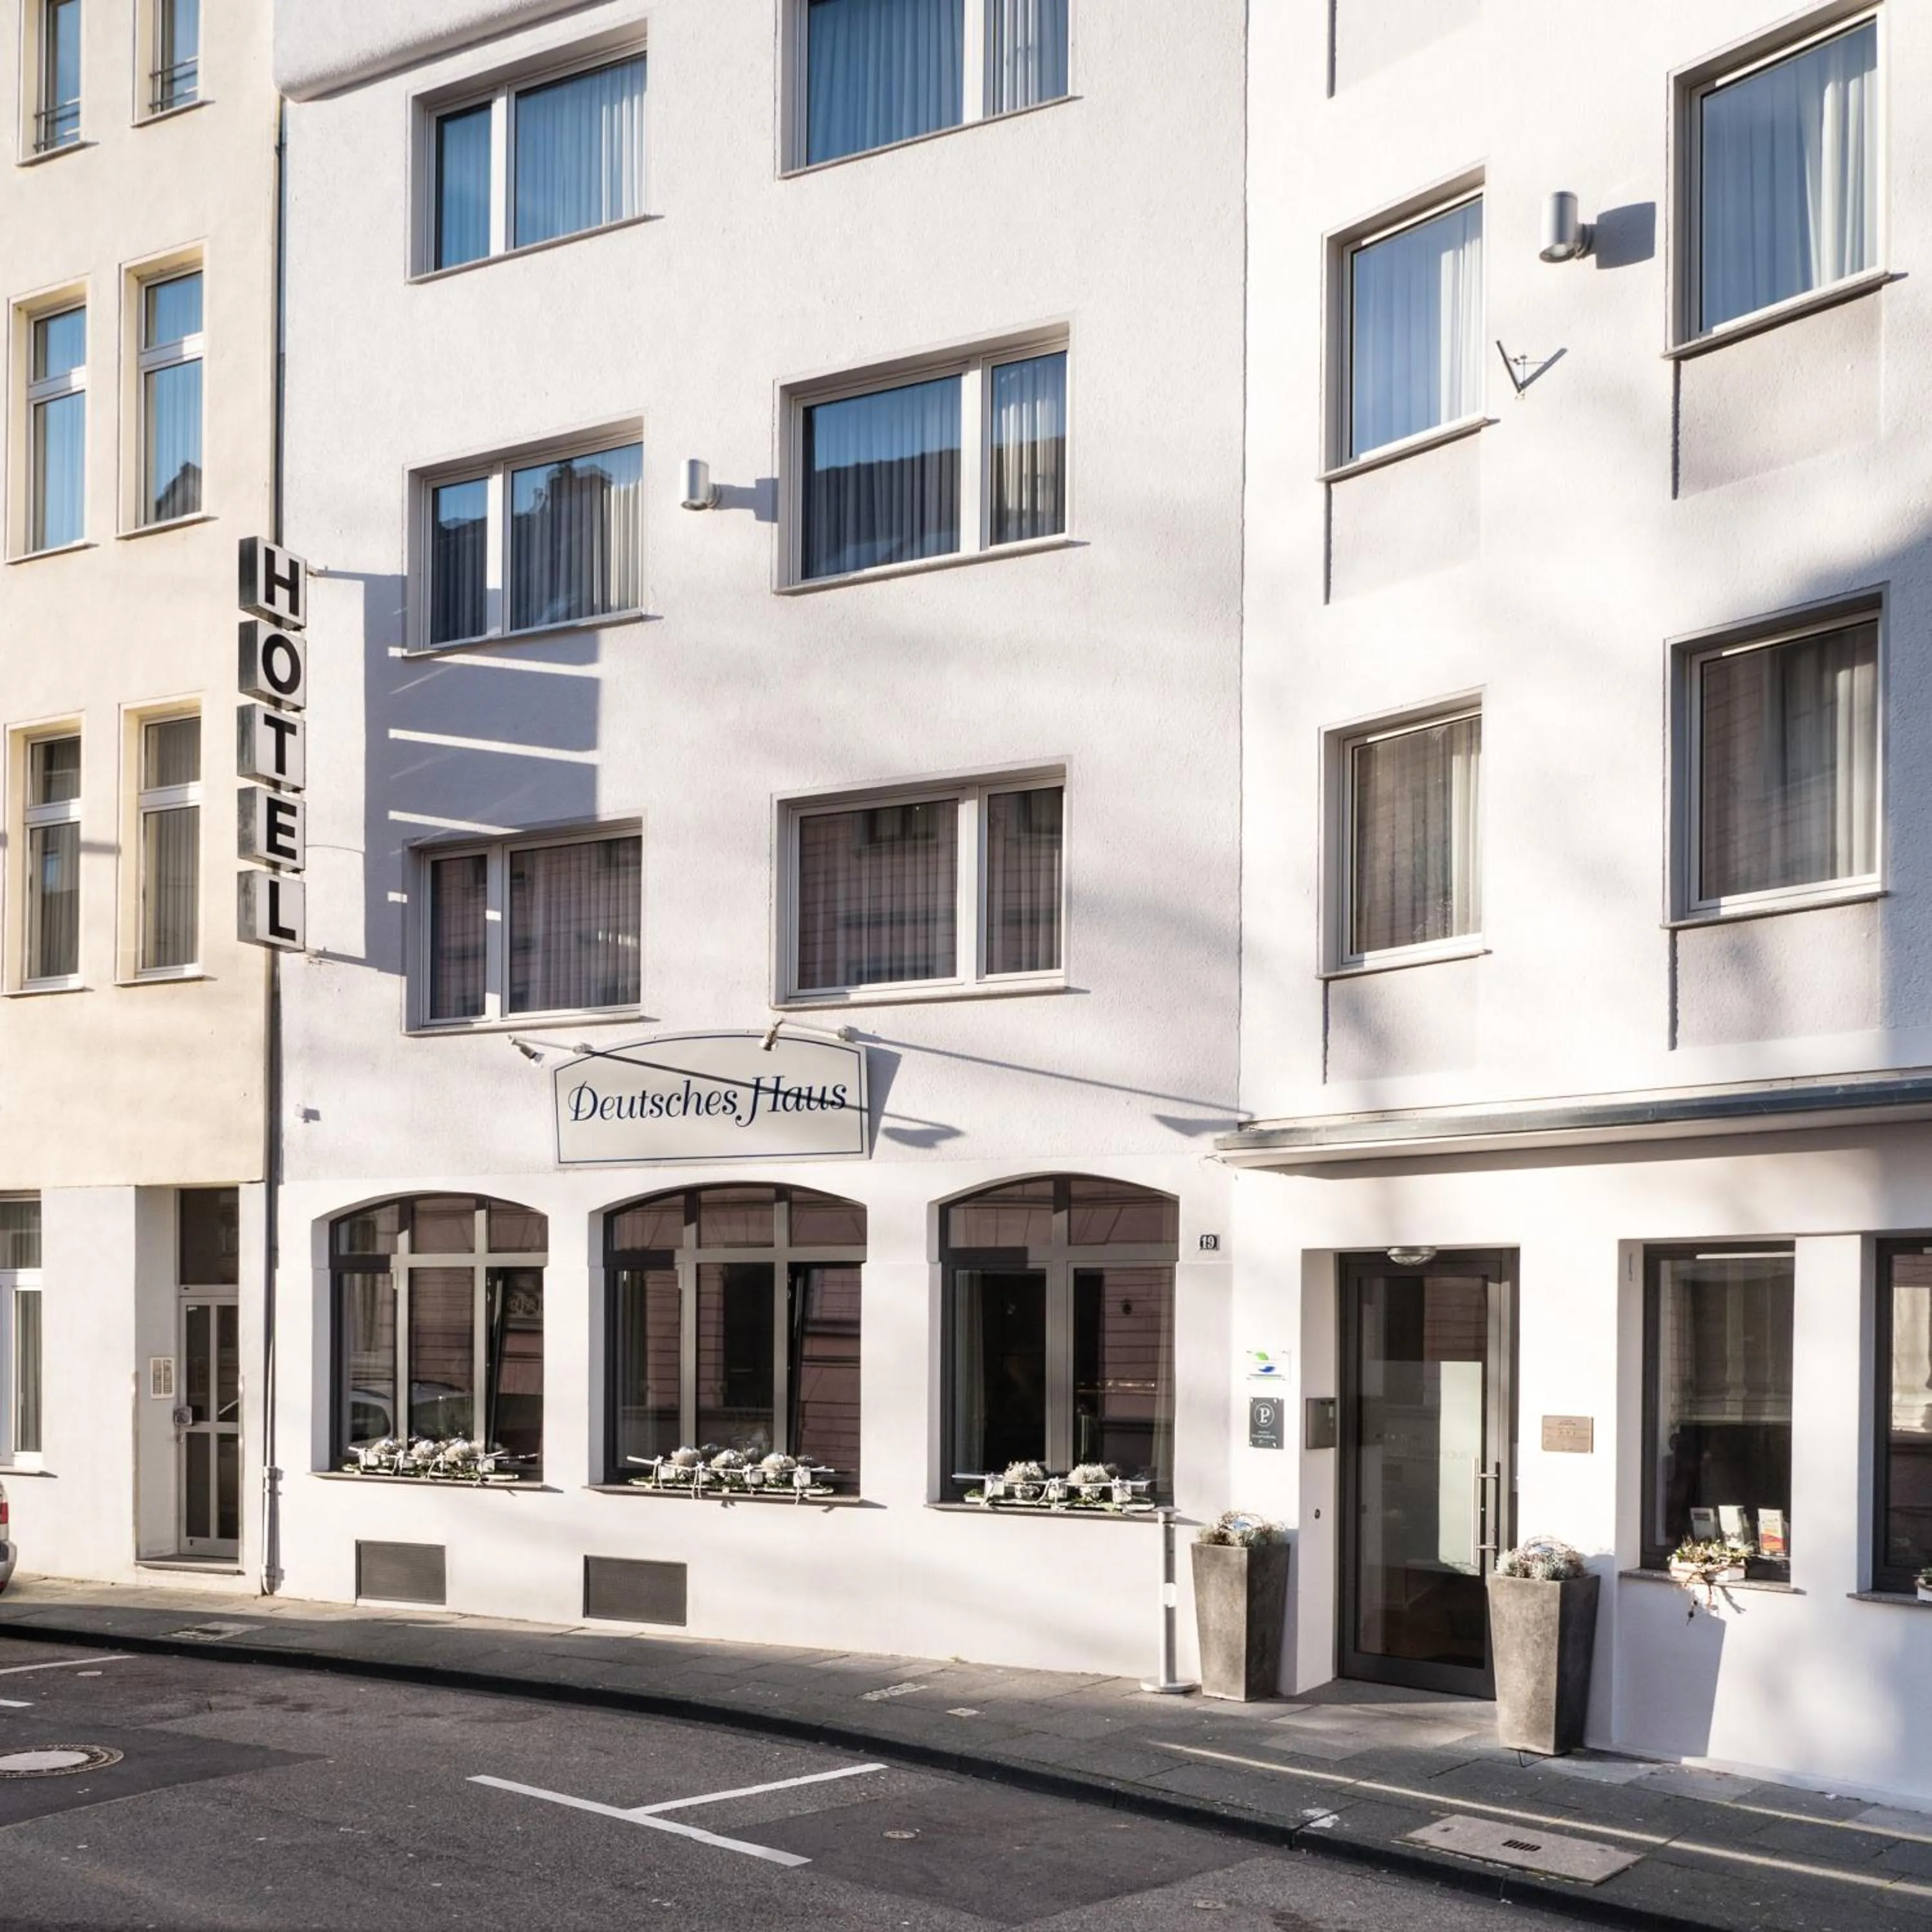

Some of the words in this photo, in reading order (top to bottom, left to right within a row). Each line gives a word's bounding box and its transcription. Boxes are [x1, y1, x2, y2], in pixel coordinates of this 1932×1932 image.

[261, 547, 301, 941] HOTEL
[569, 1080, 737, 1121] Deutsches
[735, 1075, 847, 1127] Haus
[1202, 1235, 1215, 1249] 19
